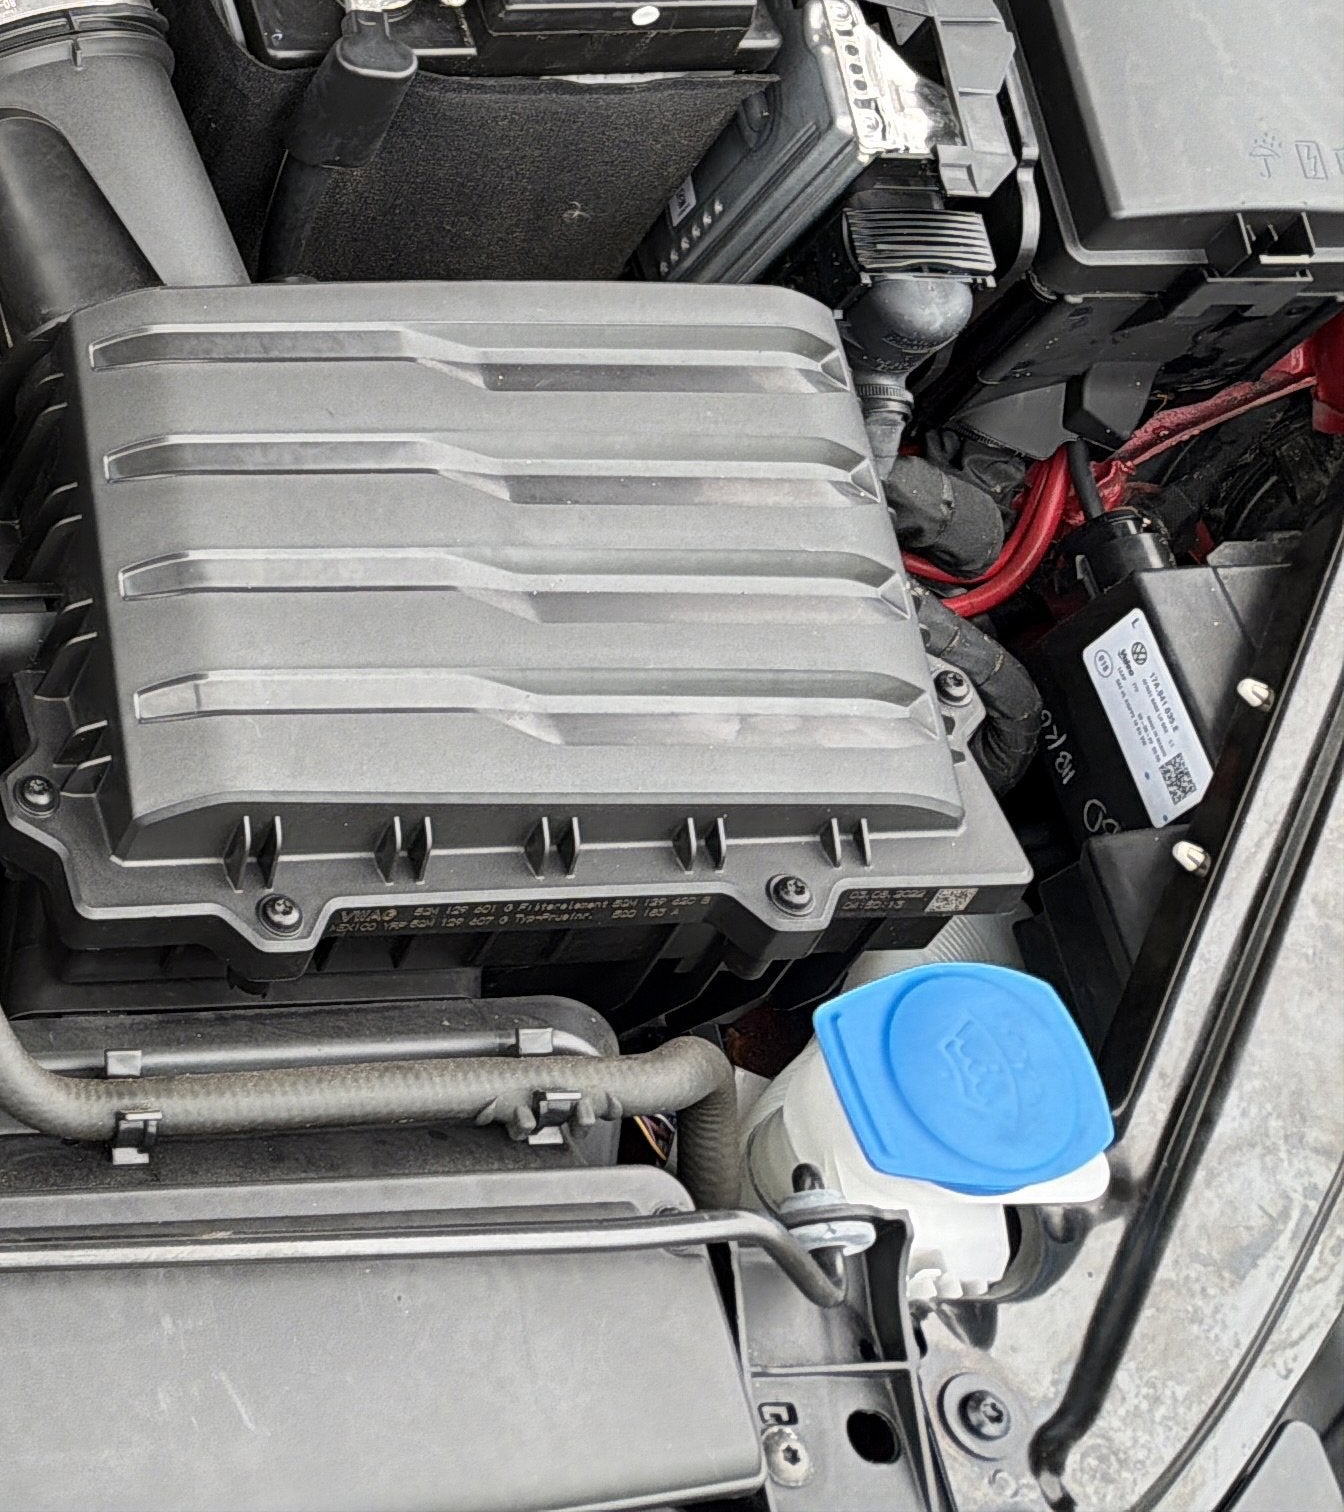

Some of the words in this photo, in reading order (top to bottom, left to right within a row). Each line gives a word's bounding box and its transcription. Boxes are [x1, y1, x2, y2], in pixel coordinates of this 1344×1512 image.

[1118, 648, 1134, 677] Valeo
[341, 909, 397, 922] VWAG
[446, 905, 468, 915] 129
[441, 917, 463, 927] 129
